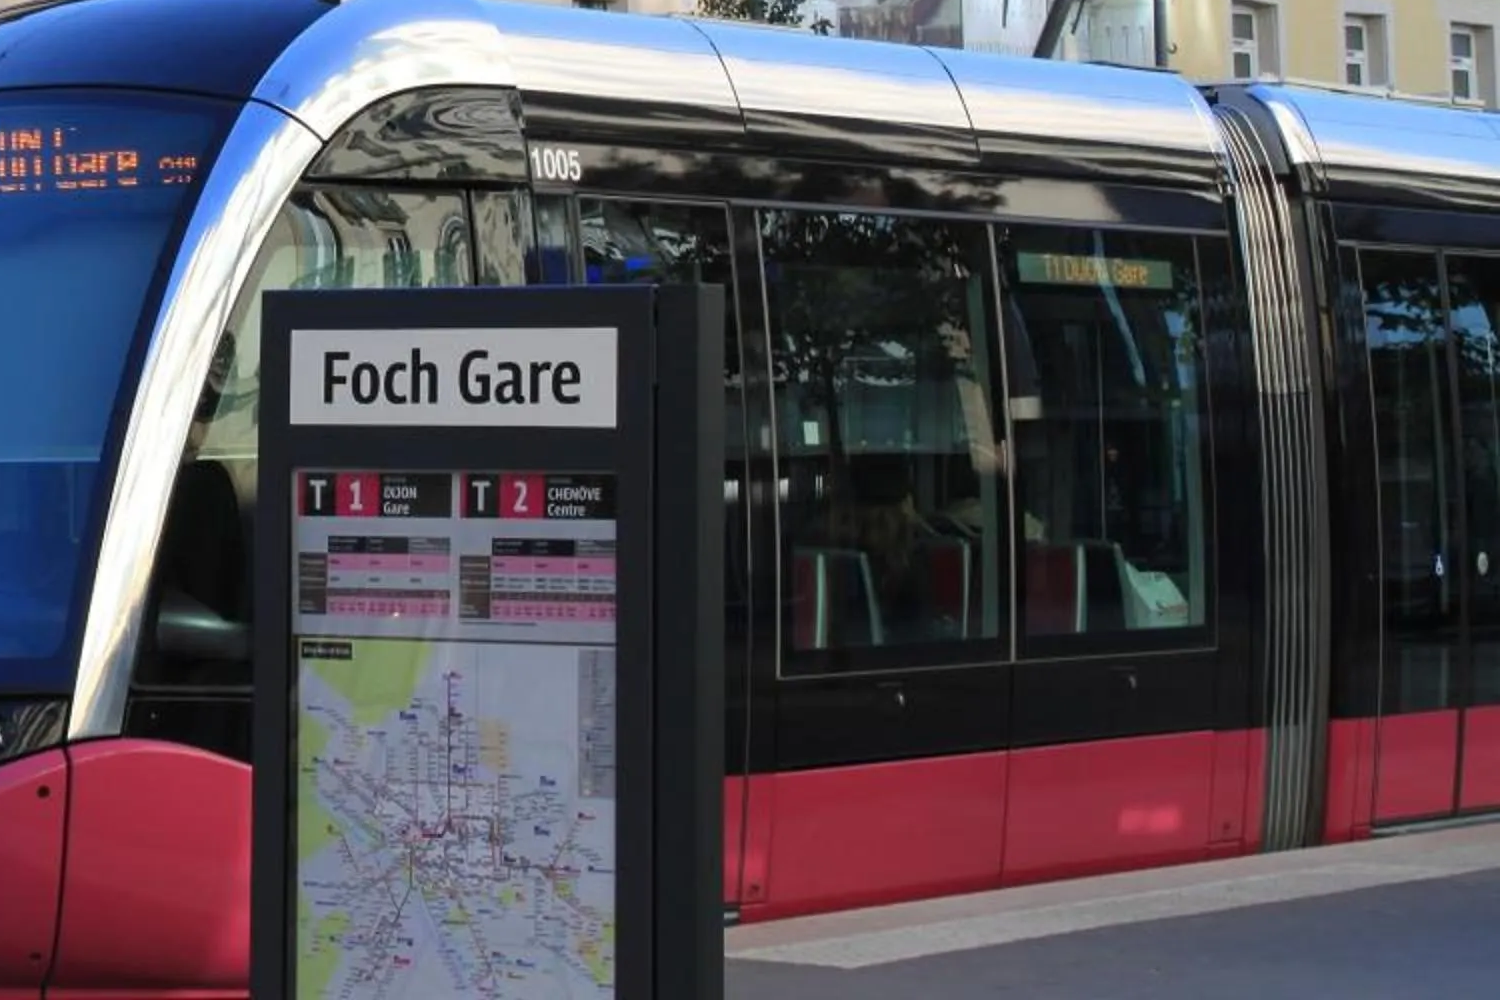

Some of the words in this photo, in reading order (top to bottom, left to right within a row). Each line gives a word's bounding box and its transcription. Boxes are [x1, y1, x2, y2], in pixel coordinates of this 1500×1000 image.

[531, 147, 581, 181] 1005
[323, 347, 438, 404] Foch
[459, 349, 581, 404] Gare
[309, 479, 327, 511] T
[349, 480, 364, 511] 1
[472, 480, 491, 511] T
[512, 480, 529, 512] 2
[547, 503, 586, 517] Centre
